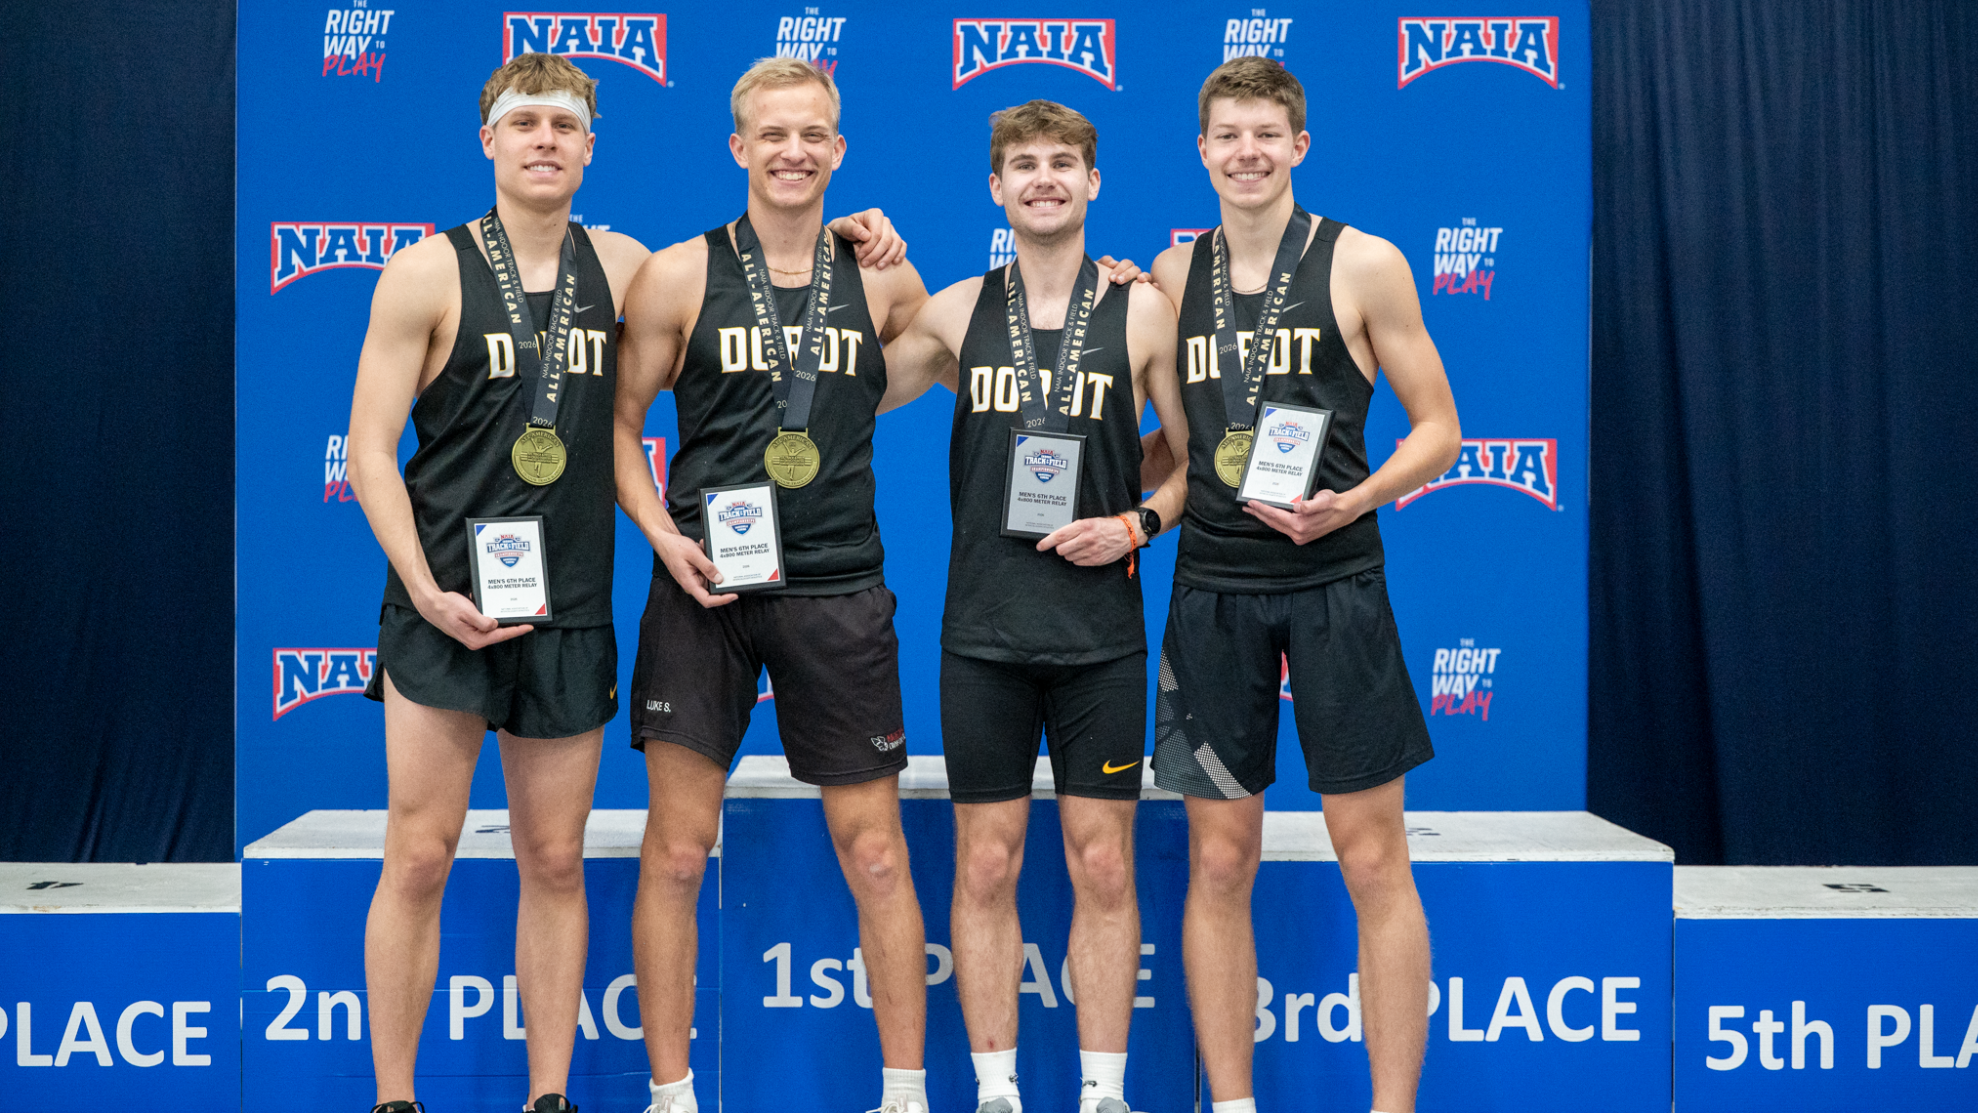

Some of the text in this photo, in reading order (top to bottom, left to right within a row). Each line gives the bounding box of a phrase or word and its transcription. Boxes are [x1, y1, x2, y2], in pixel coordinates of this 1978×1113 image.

[353, 0, 367, 8] THE
[805, 7, 819, 15] THE
[324, 9, 395, 35] RIGHT
[776, 16, 847, 42] RIGHT
[1224, 18, 1293, 43] RIGHT
[324, 35, 385, 60] WAY TO
[505, 14, 664, 79] NAIA
[827, 47, 837, 56] TO
[955, 20, 1113, 84] NAIA
[1273, 48, 1284, 57] TO
[1400, 19, 1556, 83] NAIA
[322, 51, 386, 83] PLAY
[1434, 227, 1503, 253] RIGHT
[482, 210, 522, 324] LL-AMERICAN
[507, 259, 517, 279] TRACK
[813, 269, 821, 288] TRACK
[1434, 253, 1494, 278] WAY TO
[555, 289, 563, 307] FIELD
[1432, 270, 1495, 301] PLAY
[759, 268, 767, 284] NAIA
[763, 285, 775, 313] INDOOR
[771, 313, 780, 334] TRACK
[777, 341, 786, 360] FIELD
[809, 289, 818, 316] INDOOR
[1070, 303, 1078, 320] FIELD
[551, 313, 559, 333] TRACK
[741, 253, 782, 382] ALL-AMERICAN
[518, 341, 537, 349] 2026
[545, 334, 555, 361] INDOOR
[546, 274, 576, 403] ALL-AMERICAN
[1007, 281, 1032, 402] ALL-AMERICAN
[1019, 308, 1028, 334] INDOOR
[1024, 334, 1032, 355] TRACK
[1029, 362, 1037, 380] FIELD
[1064, 327, 1073, 347] TRACK
[1220, 343, 1238, 354] 2026
[1244, 366, 1253, 383] NAIA
[1249, 337, 1261, 366] INDOOR
[1256, 315, 1267, 336] TRACK
[1264, 290, 1274, 308] FIELD
[1246, 272, 1291, 406] ALL-AMERICAN
[483, 328, 607, 379] DDT
[1058, 348, 1069, 375] INDOOR
[1059, 289, 1095, 415] ALL-AMERICAN
[542, 363, 550, 378] NAIA
[796, 370, 816, 382] 2026
[1055, 376, 1063, 392] NAIA
[777, 400, 787, 408] 20
[1399, 440, 1554, 503] AIA
[323, 480, 359, 503] PL
[1433, 648, 1501, 674] RIGHT
[275, 650, 377, 715] NA
[1432, 674, 1479, 699] WAY
[646, 700, 671, 713] LUKE S.
[1431, 690, 1493, 721] PLAY
[763, 942, 873, 1009] 1st
[265, 975, 362, 1041] 2n
[1254, 973, 1362, 1043] 3rd
[0, 1000, 212, 1067] LACE
[1706, 1000, 1834, 1071] 5th
